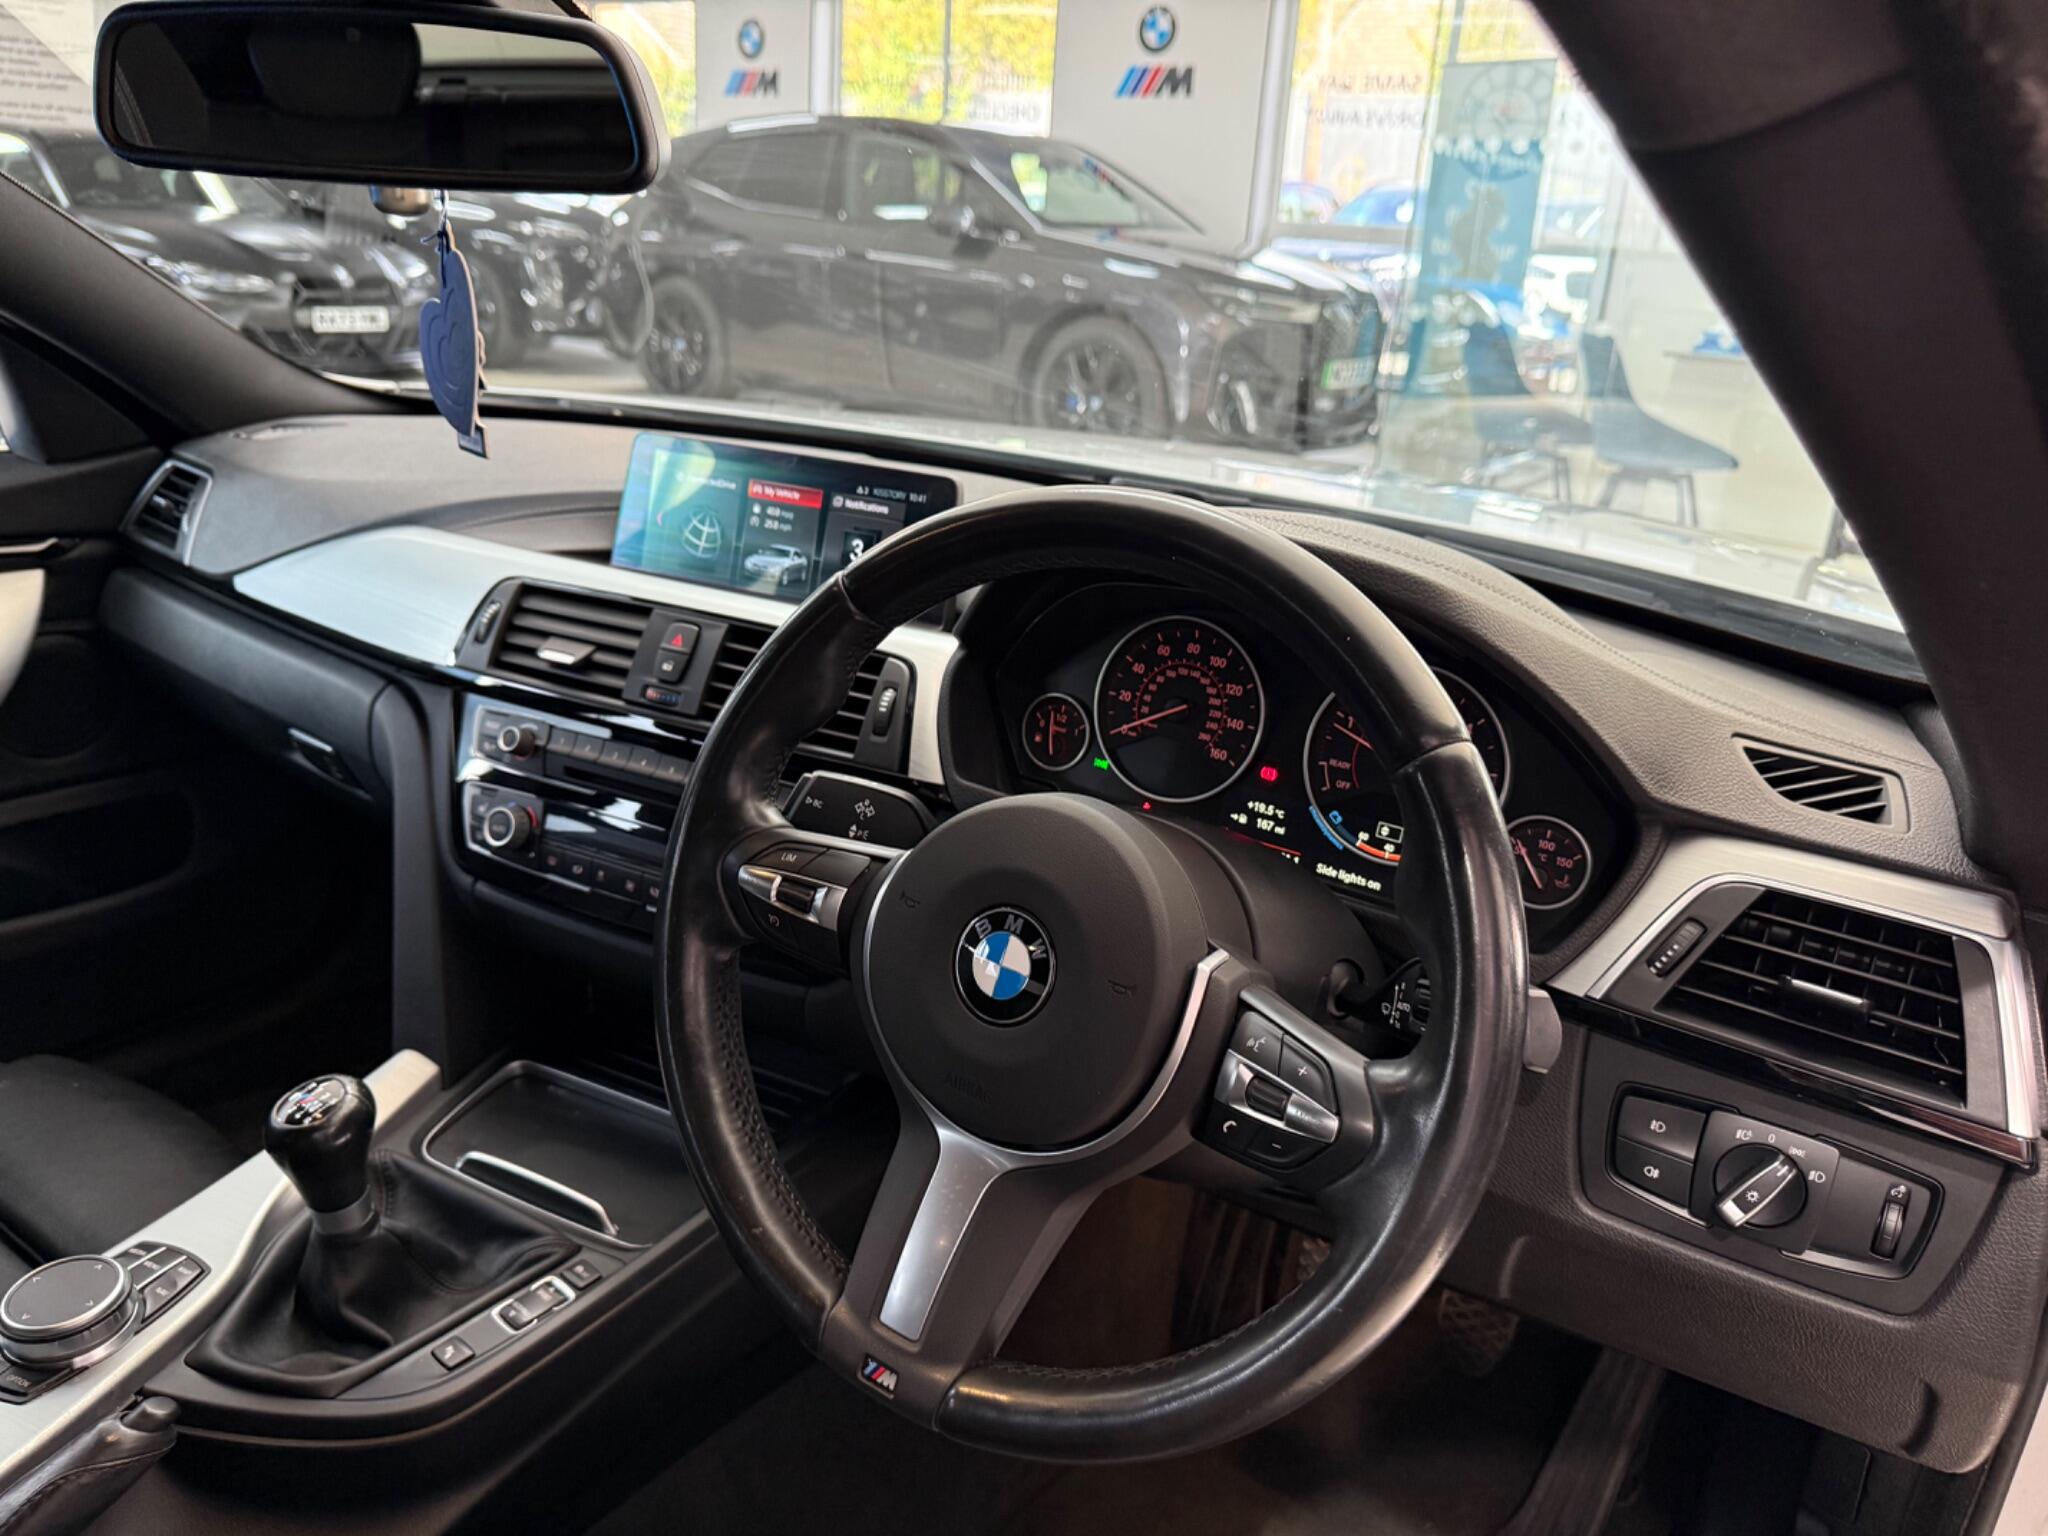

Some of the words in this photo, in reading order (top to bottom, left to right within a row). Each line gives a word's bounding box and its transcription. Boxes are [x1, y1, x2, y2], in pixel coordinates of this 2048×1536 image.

[845, 498, 889, 515] Notifications
[849, 538, 864, 561] 3
[1157, 645, 1170, 657] 60
[1187, 643, 1200, 654] 80
[1132, 662, 1145, 674] 40
[1210, 655, 1227, 669] 100
[1119, 690, 1132, 701] 20
[1226, 683, 1243, 696] 120
[1227, 718, 1244, 731] 140
[1210, 748, 1227, 760] 160
[1335, 780, 1351, 792] OFF
[1256, 817, 1275, 832] 167
[1537, 838, 1556, 852] 100
[780, 851, 798, 863] LIM
[1556, 856, 1574, 869] 150
[1316, 862, 1338, 878] Side
[1338, 868, 1367, 887] lights
[1367, 879, 1382, 892] on
[975, 913, 1048, 961] BMW
